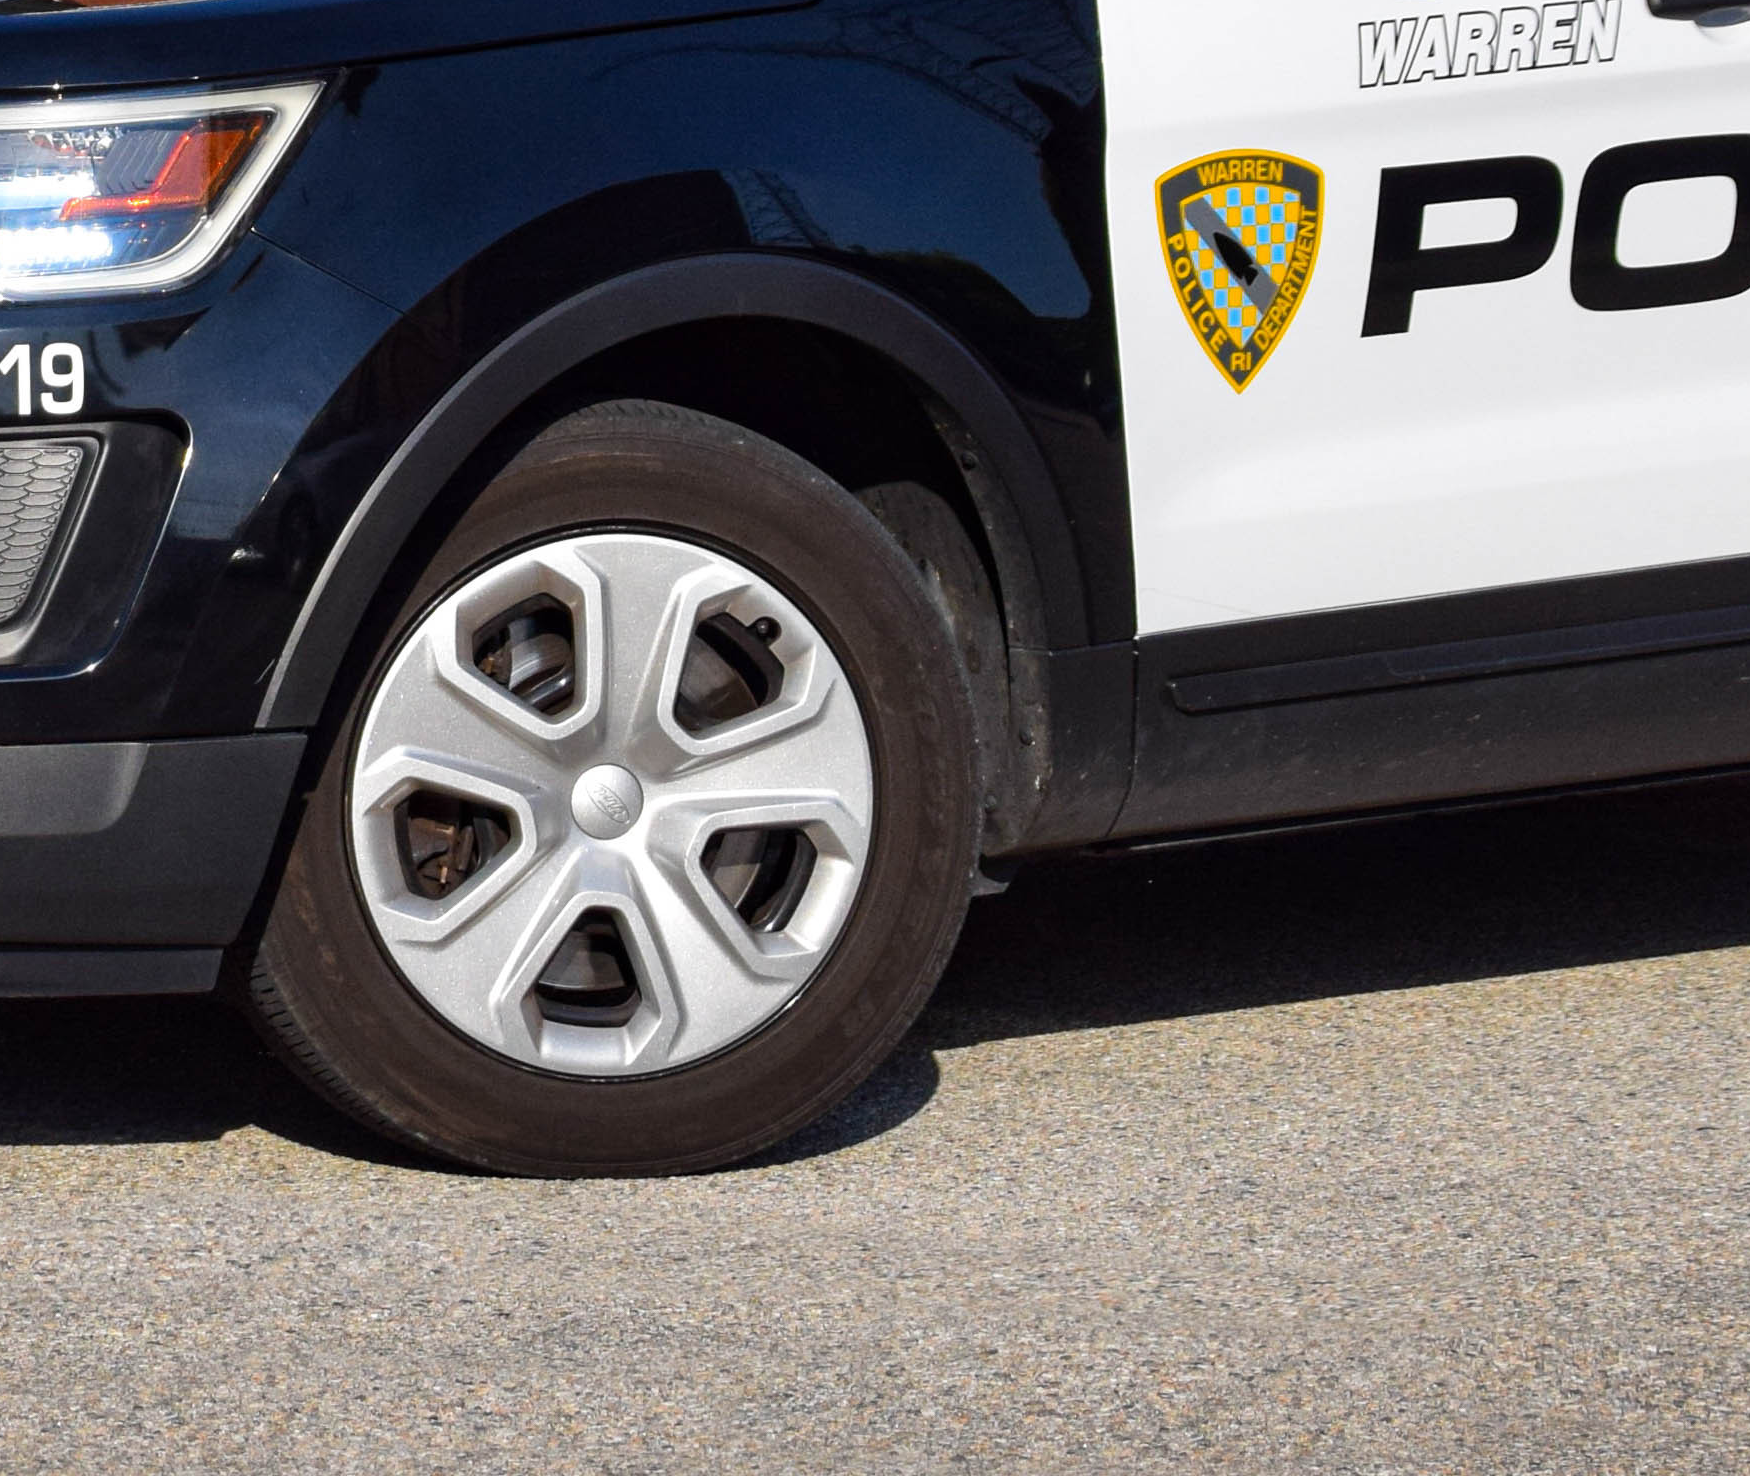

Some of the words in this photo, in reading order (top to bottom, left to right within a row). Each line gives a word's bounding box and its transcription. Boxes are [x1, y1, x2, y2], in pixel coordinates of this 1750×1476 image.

[1197, 158, 1284, 186] WARREN
[1167, 232, 1228, 353] POLICE
[1253, 205, 1318, 351] DEPARTMENT
[1230, 351, 1252, 372] RI
